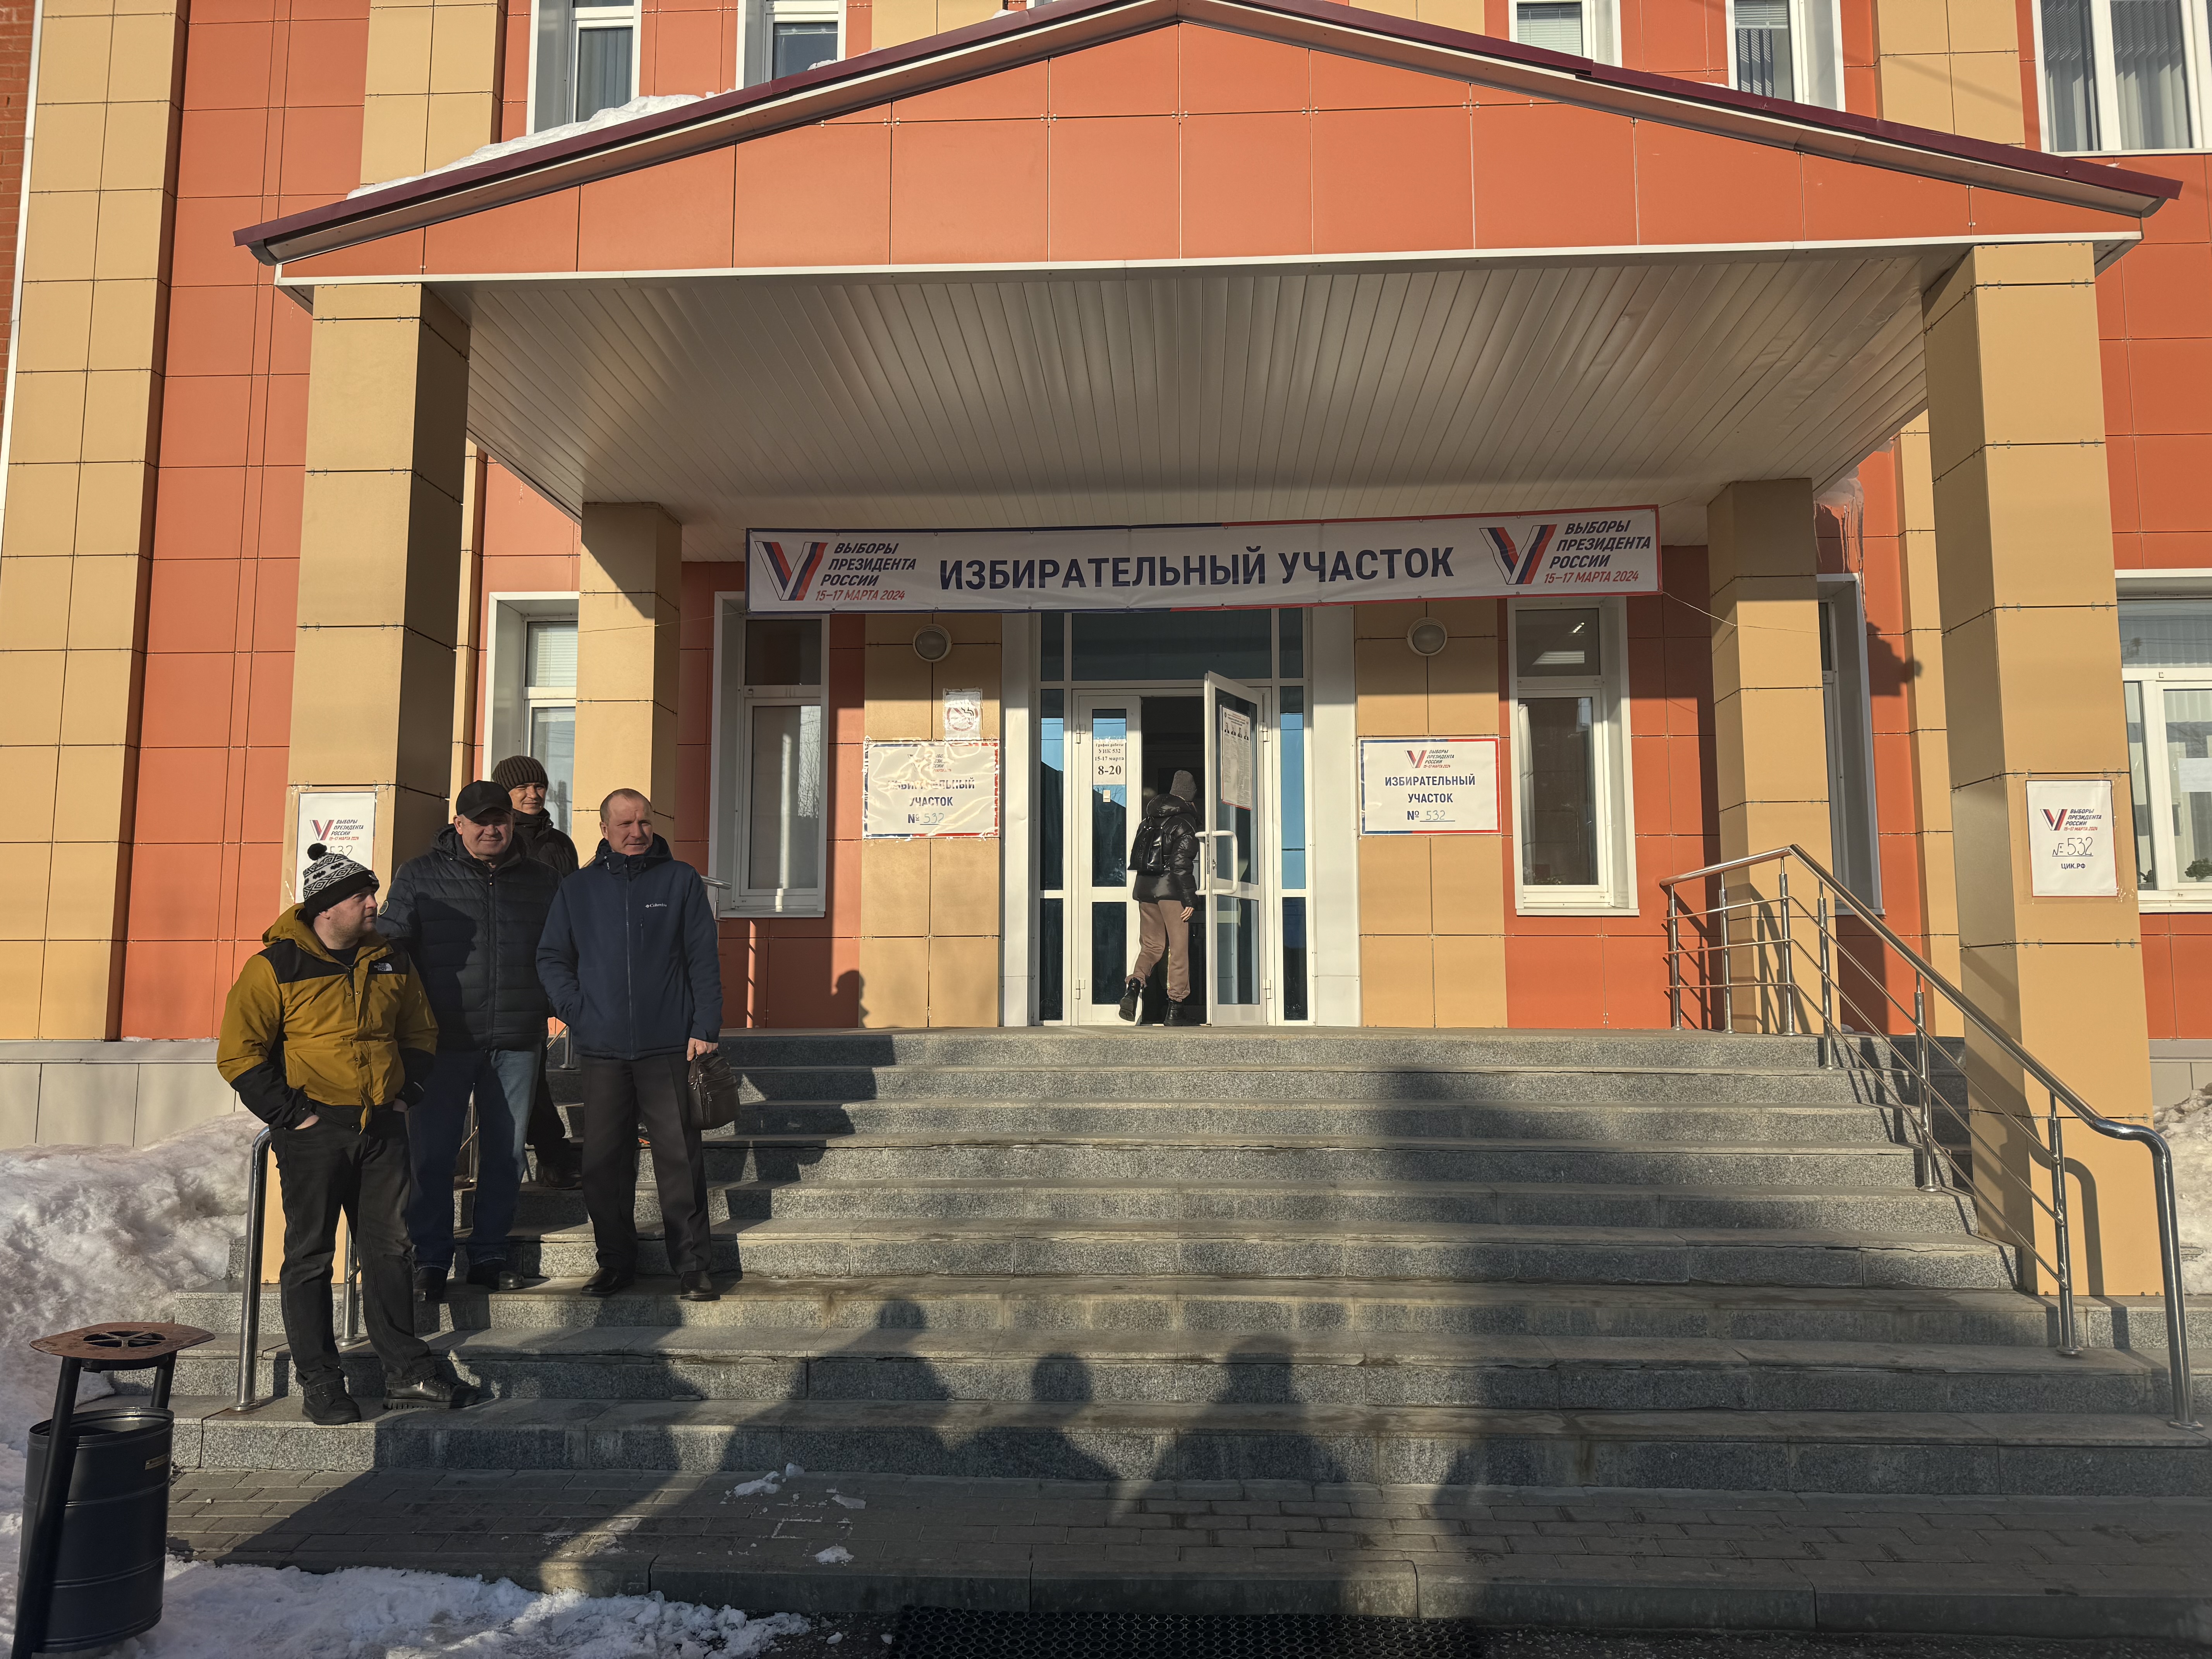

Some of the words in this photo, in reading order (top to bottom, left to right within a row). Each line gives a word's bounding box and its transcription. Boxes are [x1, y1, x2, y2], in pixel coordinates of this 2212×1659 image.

[1565, 520, 1631, 534] ВЫБОРЫ
[834, 543, 899, 554] ВЫБОРЫ
[1556, 536, 1651, 551] ПРЕЗИДЕНТА
[828, 558, 916, 572] ПРЕЗИДЕНТА
[1549, 555, 1611, 568] РОССИИ
[940, 546, 1266, 590] ИЗБИРАТЕЛЬНЫЙ
[1278, 547, 1454, 584] УЧАСТОК
[820, 574, 879, 586] РОССИИ
[1575, 571, 1611, 582] МАРТА
[1613, 570, 1638, 582] 2024
[844, 590, 879, 600] МАРТА
[880, 590, 905, 600] 2024
[1098, 765, 1121, 775] 8-20
[1385, 774, 1475, 786] ИЗБИРАТЕЛЬНЫЙ
[910, 797, 953, 806] УЧАСТОК
[1408, 793, 1453, 803] УЧАСТОК
[923, 813, 944, 823] 532
[1425, 810, 1446, 821] 532
[2067, 836, 2093, 856] 532
